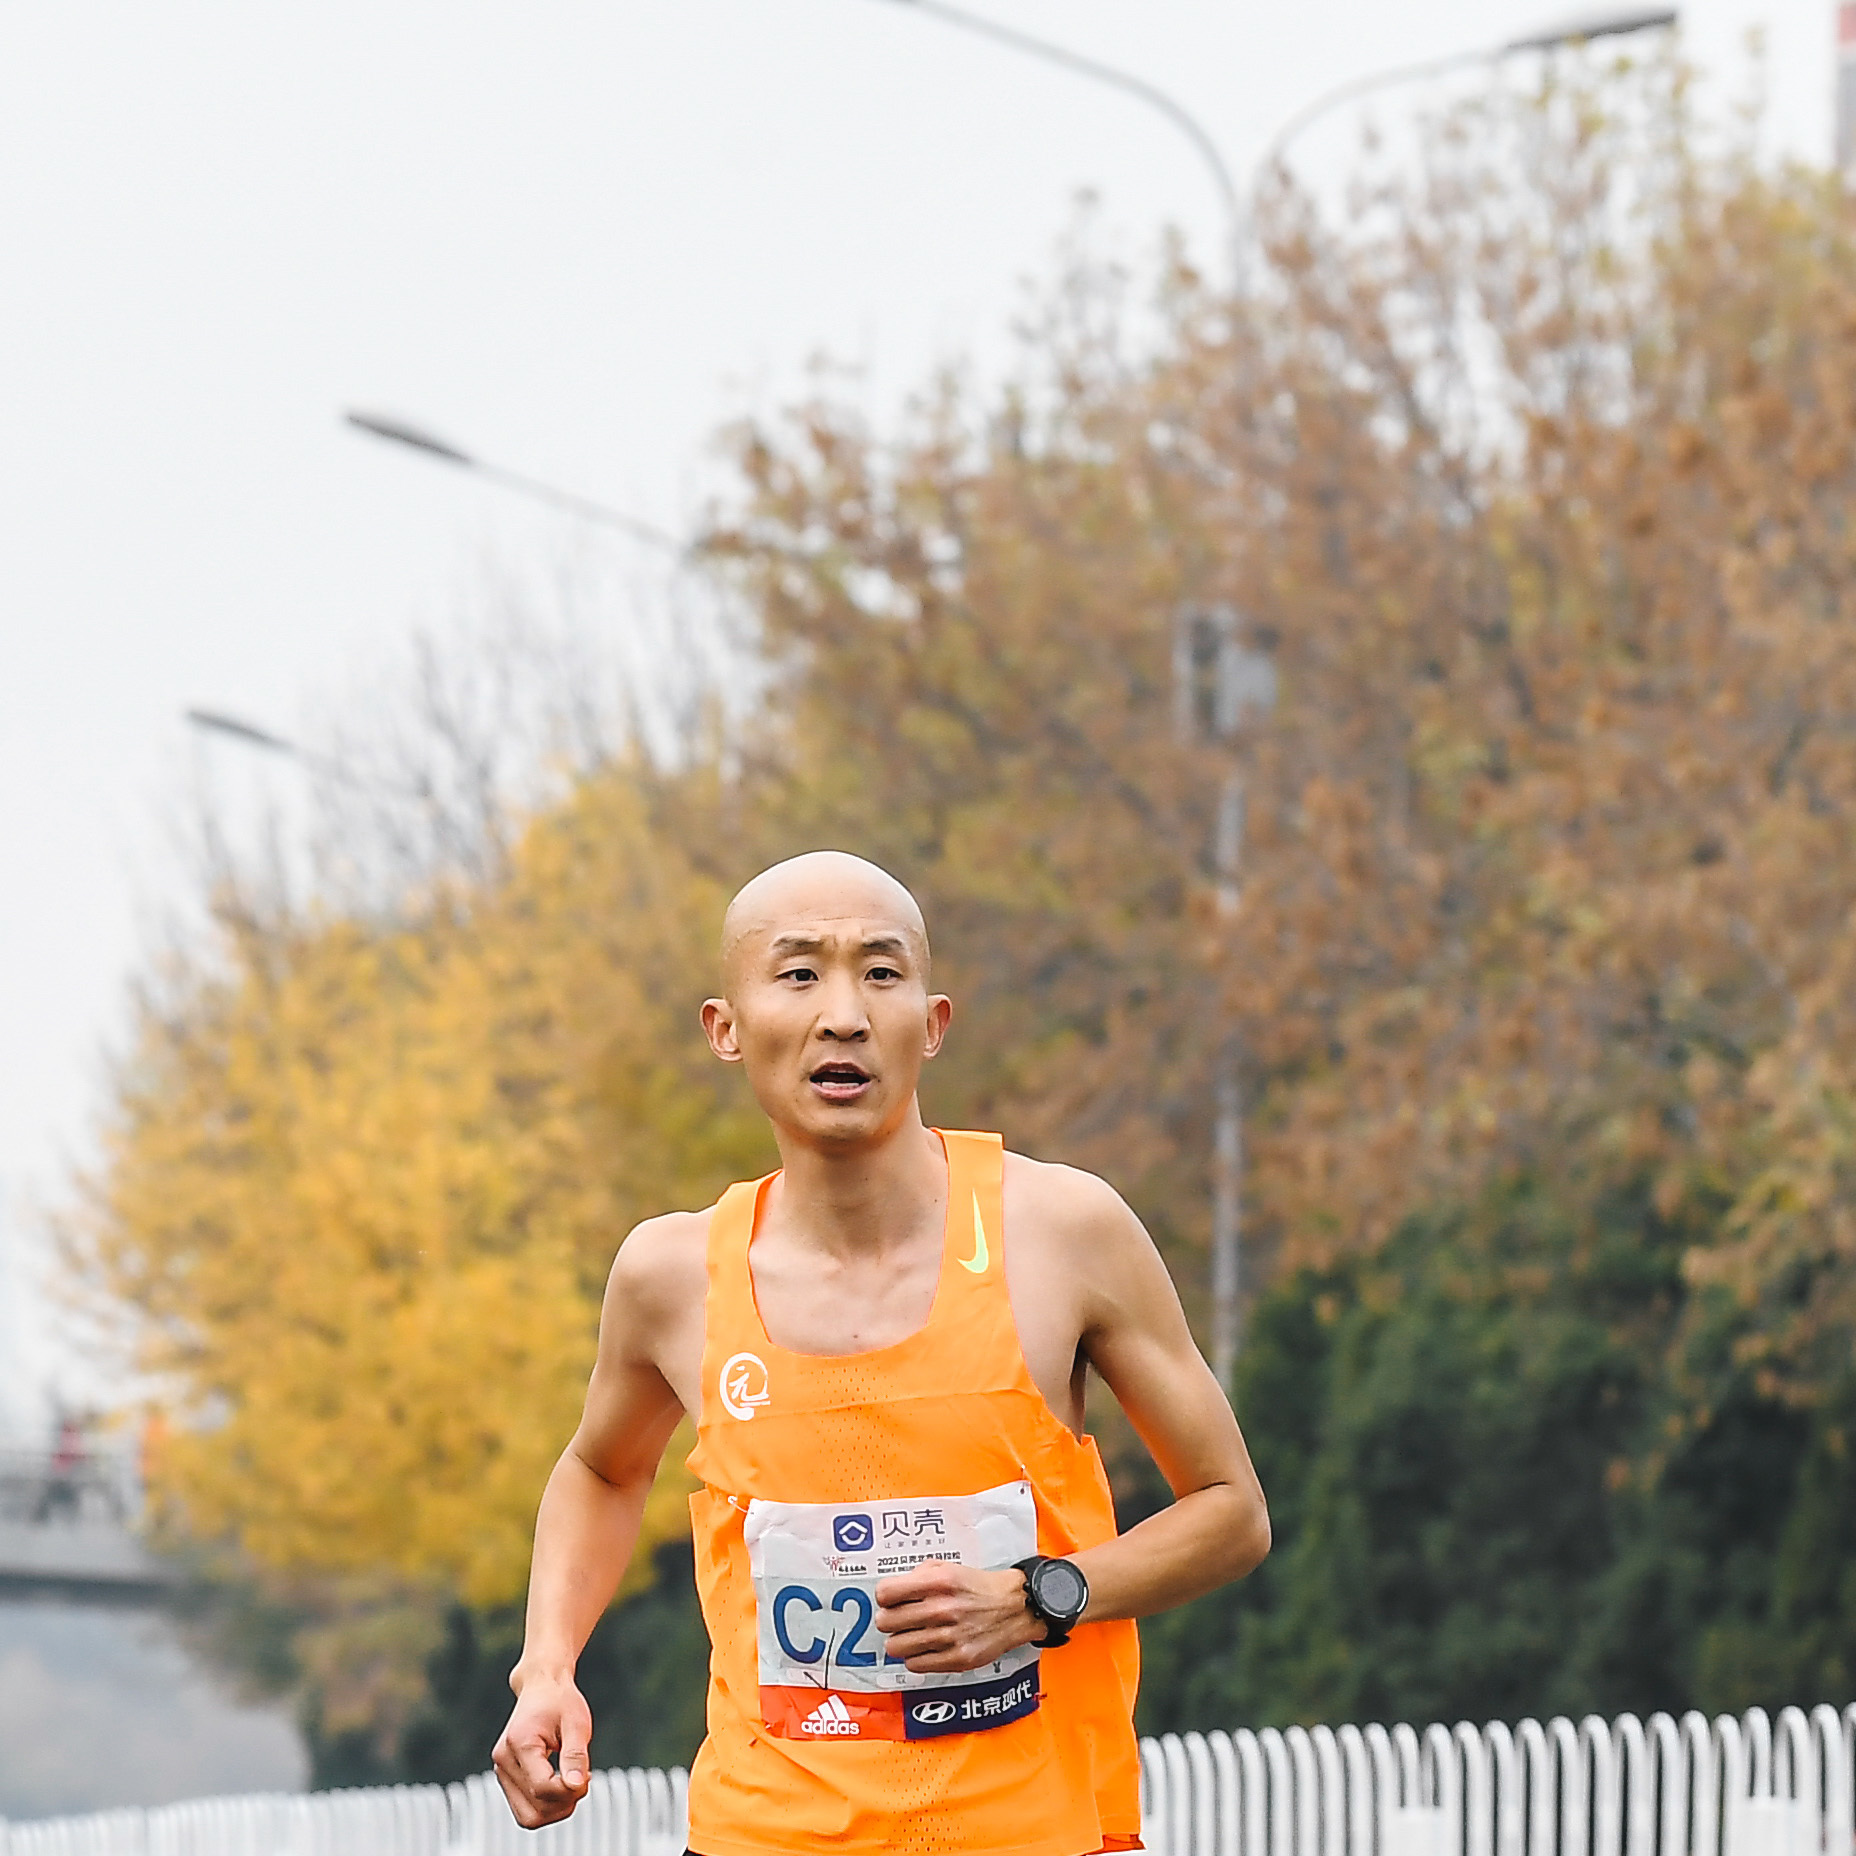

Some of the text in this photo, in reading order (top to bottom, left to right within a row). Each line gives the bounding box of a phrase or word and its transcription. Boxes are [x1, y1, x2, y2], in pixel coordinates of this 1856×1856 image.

[882, 1508, 946, 1539] 贝壳
[772, 1584, 906, 1667] C2
[961, 1679, 1032, 1720] 北京现代
[801, 1718, 860, 1735] adidas
